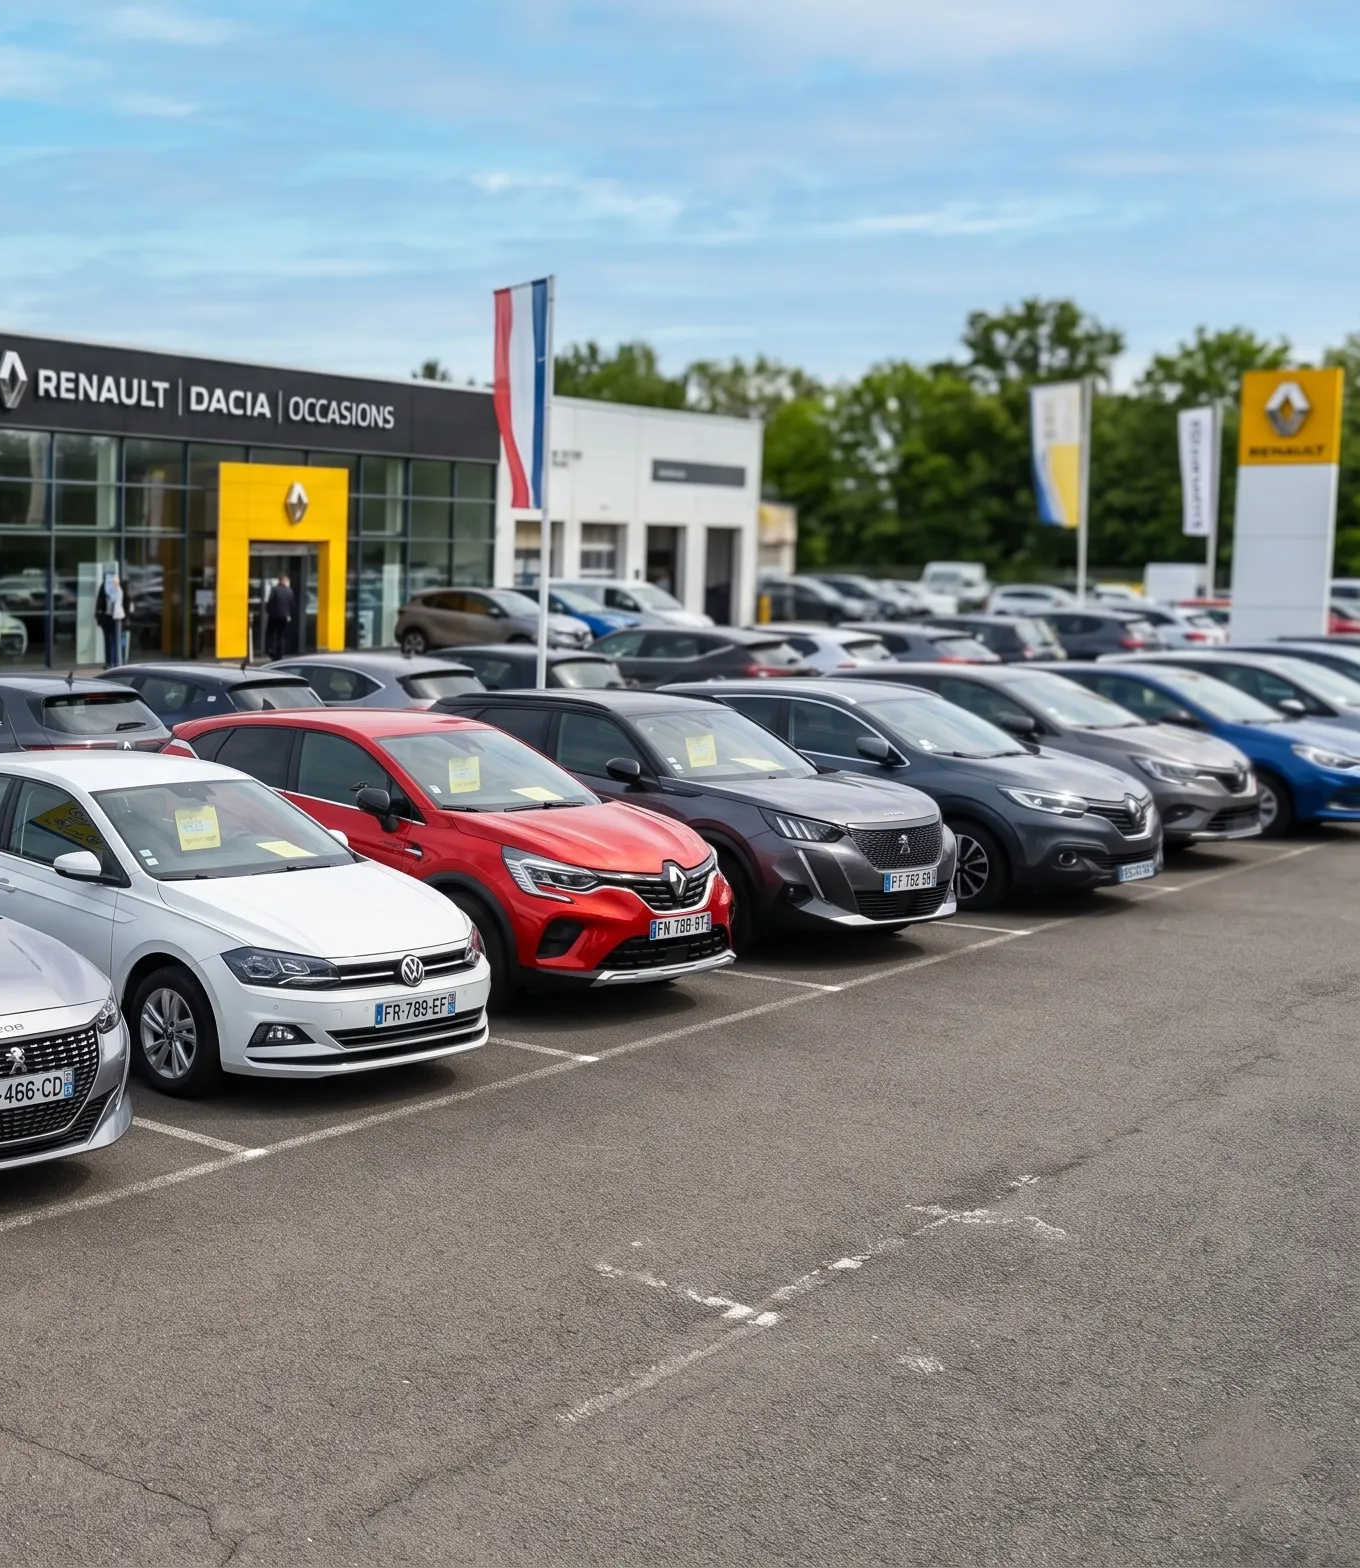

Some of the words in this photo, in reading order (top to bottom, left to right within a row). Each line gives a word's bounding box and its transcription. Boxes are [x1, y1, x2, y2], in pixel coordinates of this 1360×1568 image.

[37, 368, 170, 409] RENAULT
[189, 385, 272, 419] DACIA
[288, 395, 395, 429] OCCASIONS
